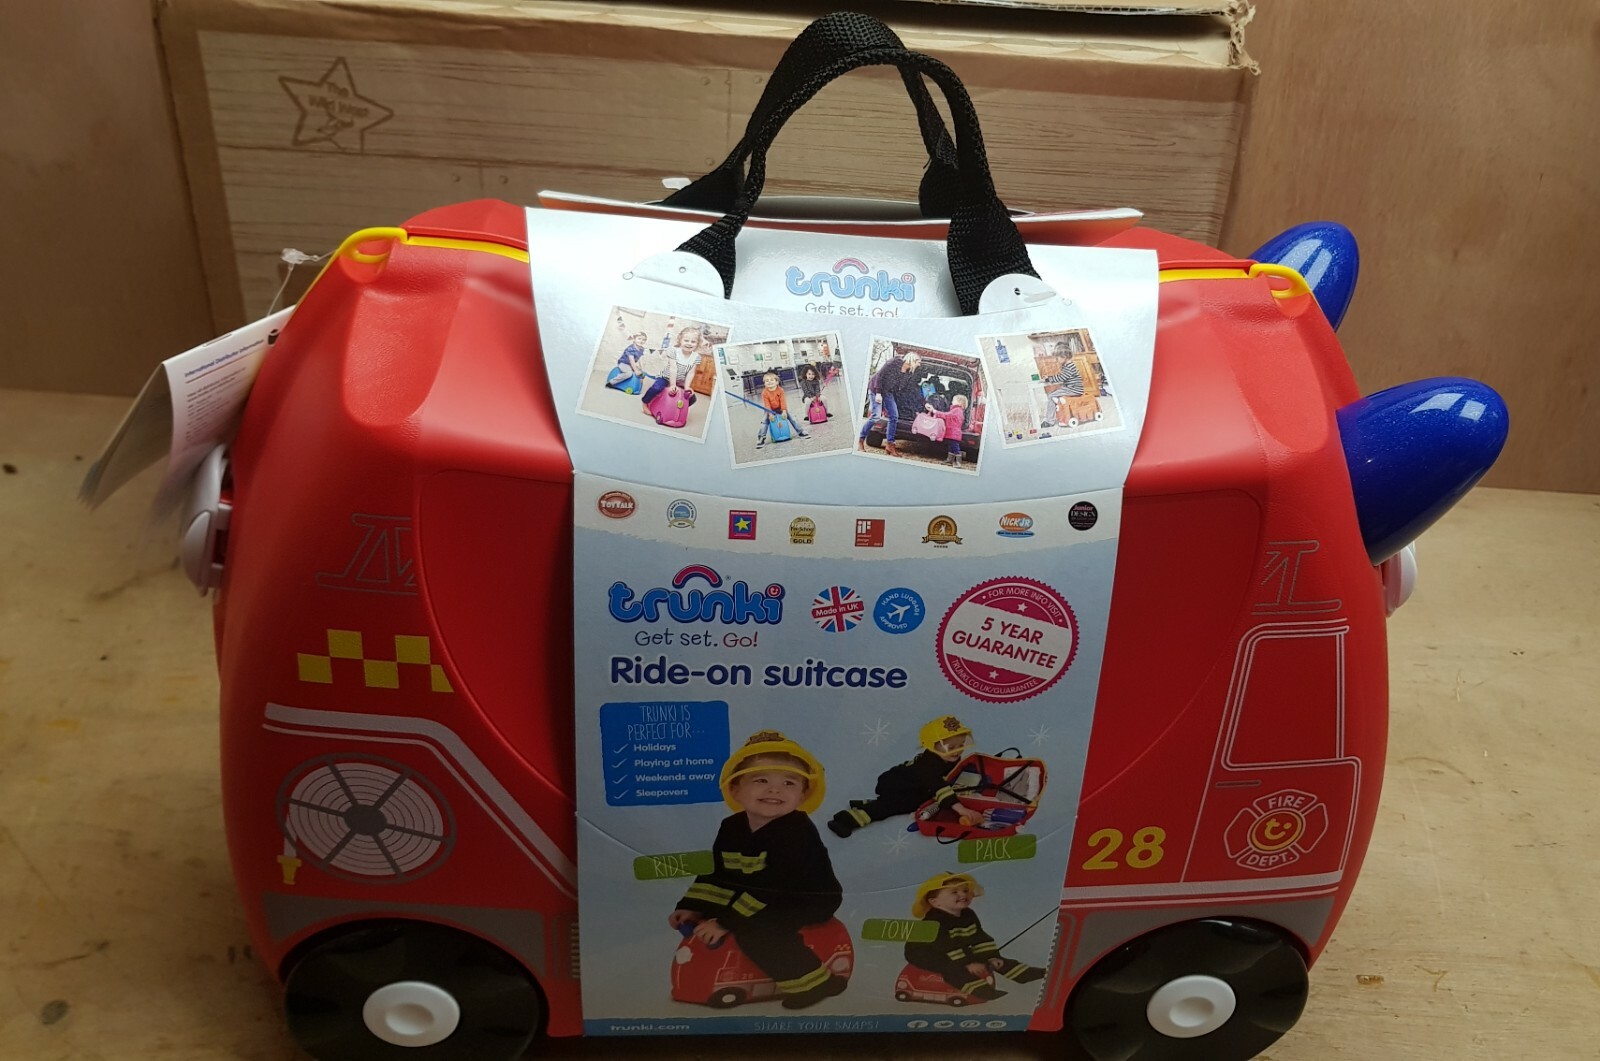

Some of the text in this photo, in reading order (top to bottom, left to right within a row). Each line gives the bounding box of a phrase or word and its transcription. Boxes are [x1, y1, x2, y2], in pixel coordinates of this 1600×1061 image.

[785, 265, 916, 302] trunki
[608, 581, 786, 625] trunki
[815, 602, 859, 617] Made in UK
[881, 592, 920, 616] HAND LUGGAGE
[988, 587, 1063, 618] FOR MORE INFO VISIT
[880, 616, 908, 630] APPROVED
[981, 617, 1044, 645] 5 YEAR
[634, 627, 759, 648] Get set. Go!
[952, 630, 1058, 669] GUARANTEE
[610, 655, 908, 689] Ride-on suitcase
[640, 704, 691, 722] TRUNKI IS
[627, 723, 668, 740] PERFECT
[633, 743, 677, 753] Holidays
[634, 757, 714, 768] Playing at home
[635, 773, 716, 782] Weekends away
[636, 789, 689, 798] Sleepovers
[1267, 794, 1306, 810] FIRE
[975, 838, 1012, 860] PACK
[1082, 826, 1167, 871] 28
[653, 853, 691, 878] RIDE
[880, 920, 915, 941] TOW
[610, 1023, 690, 1031] trunki.com
[754, 1021, 792, 1032] SHARE
[798, 1020, 831, 1031] YOUR
